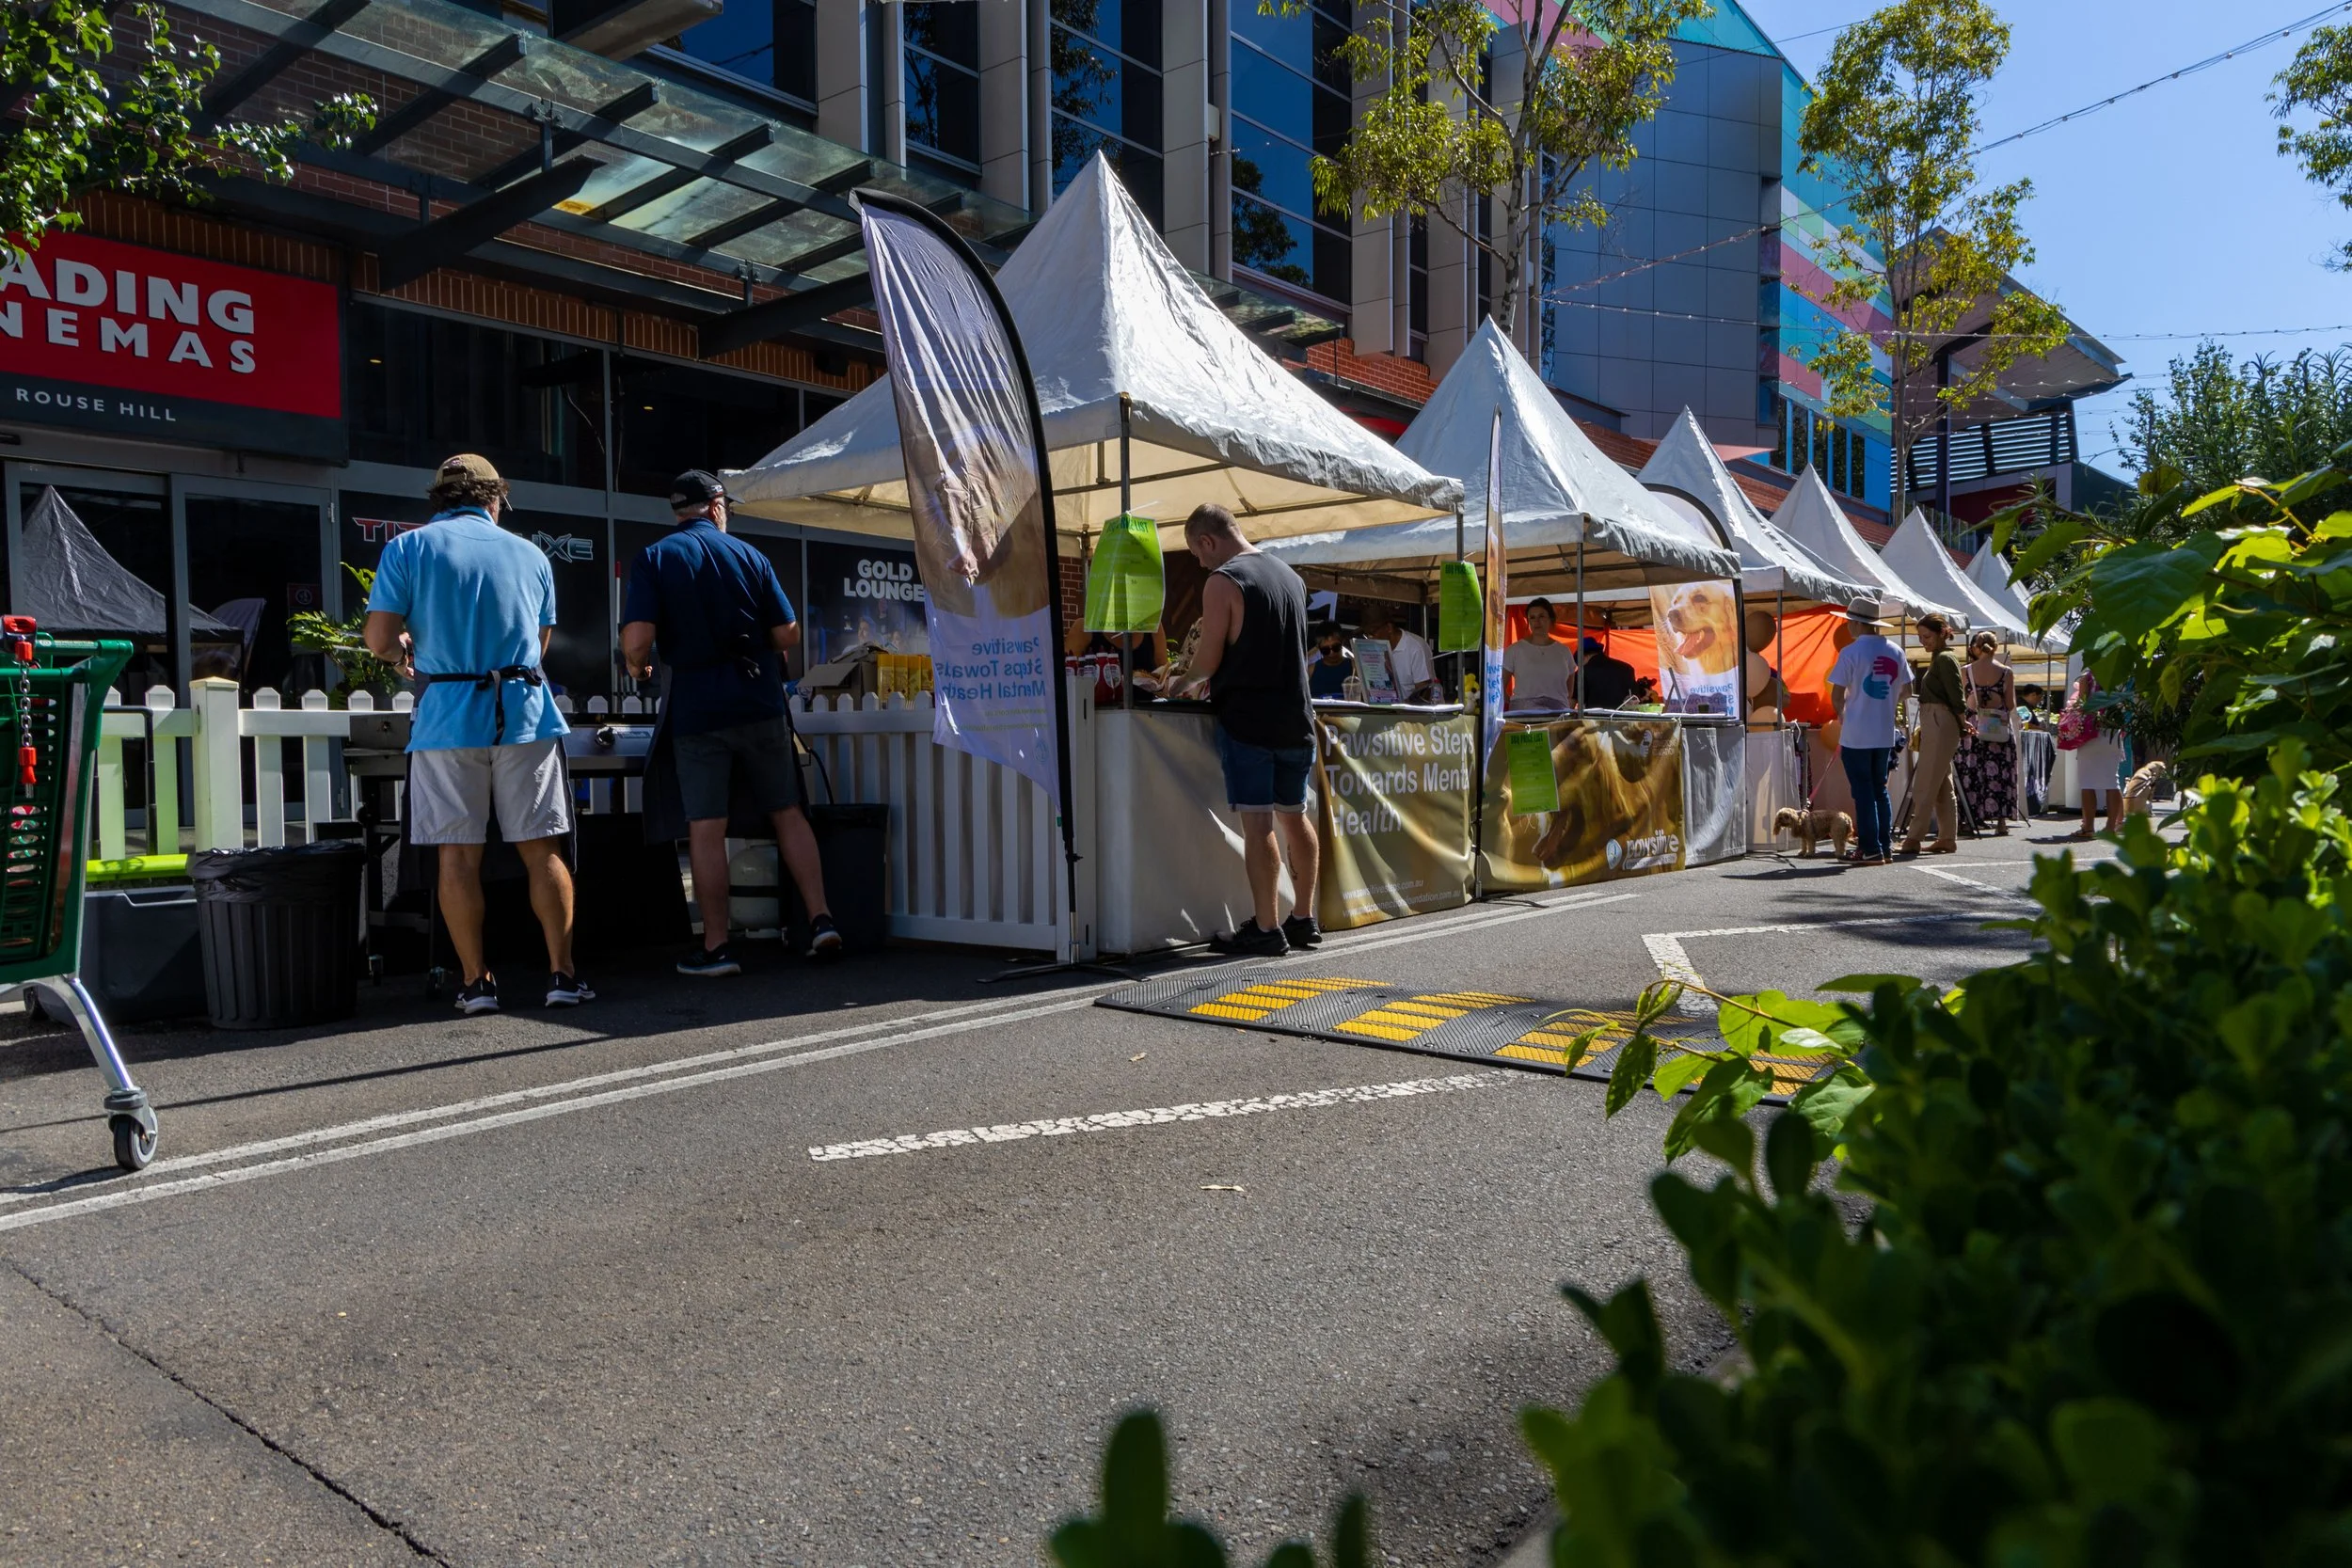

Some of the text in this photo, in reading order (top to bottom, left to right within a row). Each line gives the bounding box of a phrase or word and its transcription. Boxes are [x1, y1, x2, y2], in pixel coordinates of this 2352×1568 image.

[16, 388, 176, 421] ROUSE HILL
[857, 559, 914, 581] GOLD
[844, 578, 926, 602] LOUNGE
[1325, 725, 1474, 761] Pawsitive Steps
[1325, 763, 1417, 797] Towards
[1330, 802, 1402, 838] Health
[1627, 829, 1679, 858] pawsitive
